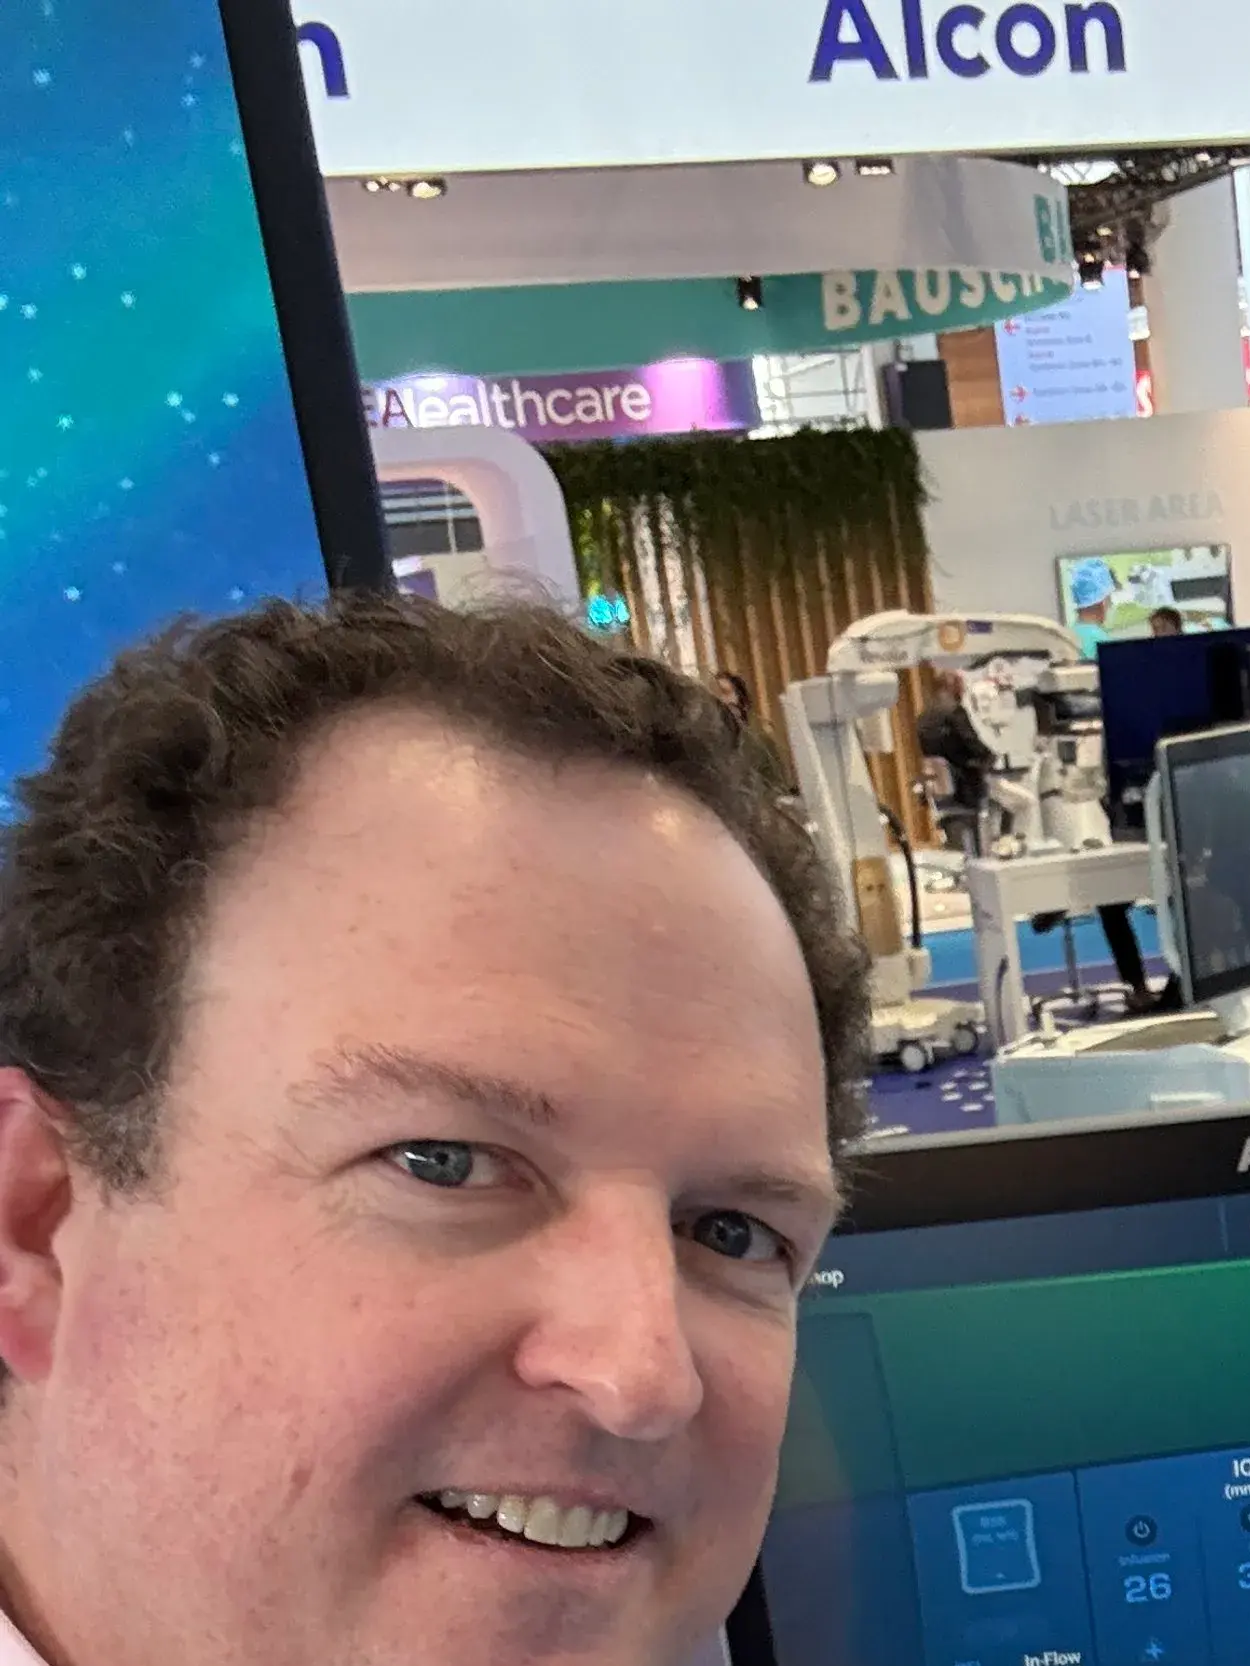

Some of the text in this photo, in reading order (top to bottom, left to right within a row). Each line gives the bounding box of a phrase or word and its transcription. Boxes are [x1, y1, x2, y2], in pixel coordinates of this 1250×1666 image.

[808, 0, 1127, 82] Alcon
[1050, 496, 1139, 531] LASER
[1124, 1572, 1172, 1603] 26
